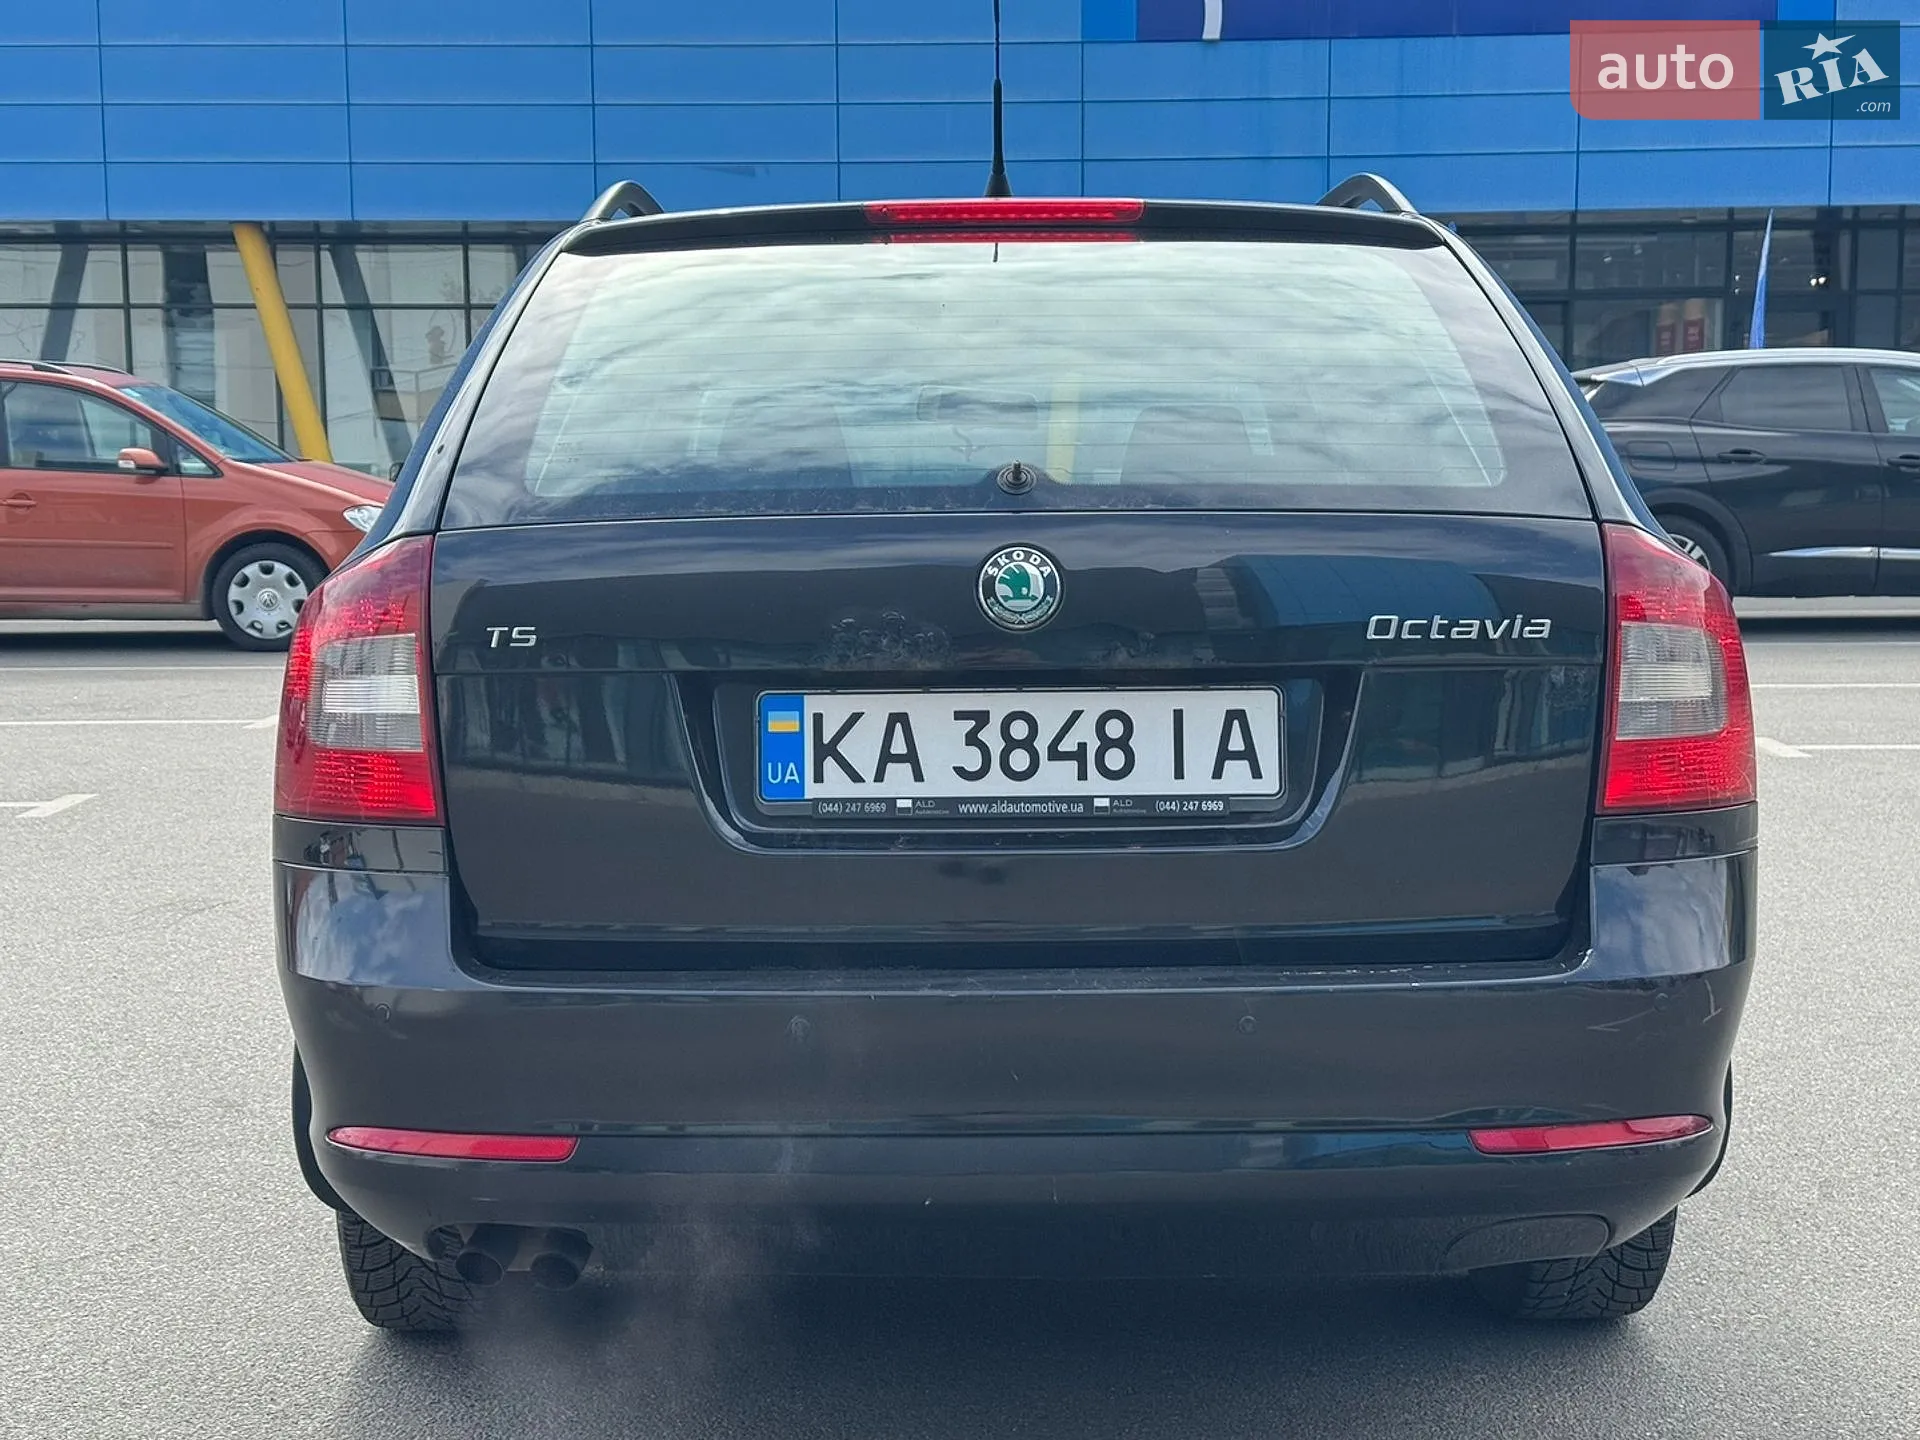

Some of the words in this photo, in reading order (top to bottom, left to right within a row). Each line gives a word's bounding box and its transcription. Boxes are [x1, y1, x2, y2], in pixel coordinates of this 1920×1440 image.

[1366, 614, 1552, 640] Octavia
[486, 626, 537, 648] TS
[812, 711, 925, 784] KA
[952, 709, 1136, 782] 3848
[767, 762, 800, 785] UA
[818, 801, 843, 815] (044)
[845, 802, 862, 813] 247
[864, 802, 887, 813] 6969
[915, 800, 936, 808] ALD
[958, 799, 1084, 814] www.aldautomotive.ua
[1112, 799, 1133, 807] ALD
[1155, 799, 1180, 813] (044)
[1182, 801, 1199, 811] 247
[1201, 801, 1224, 811] 6969
